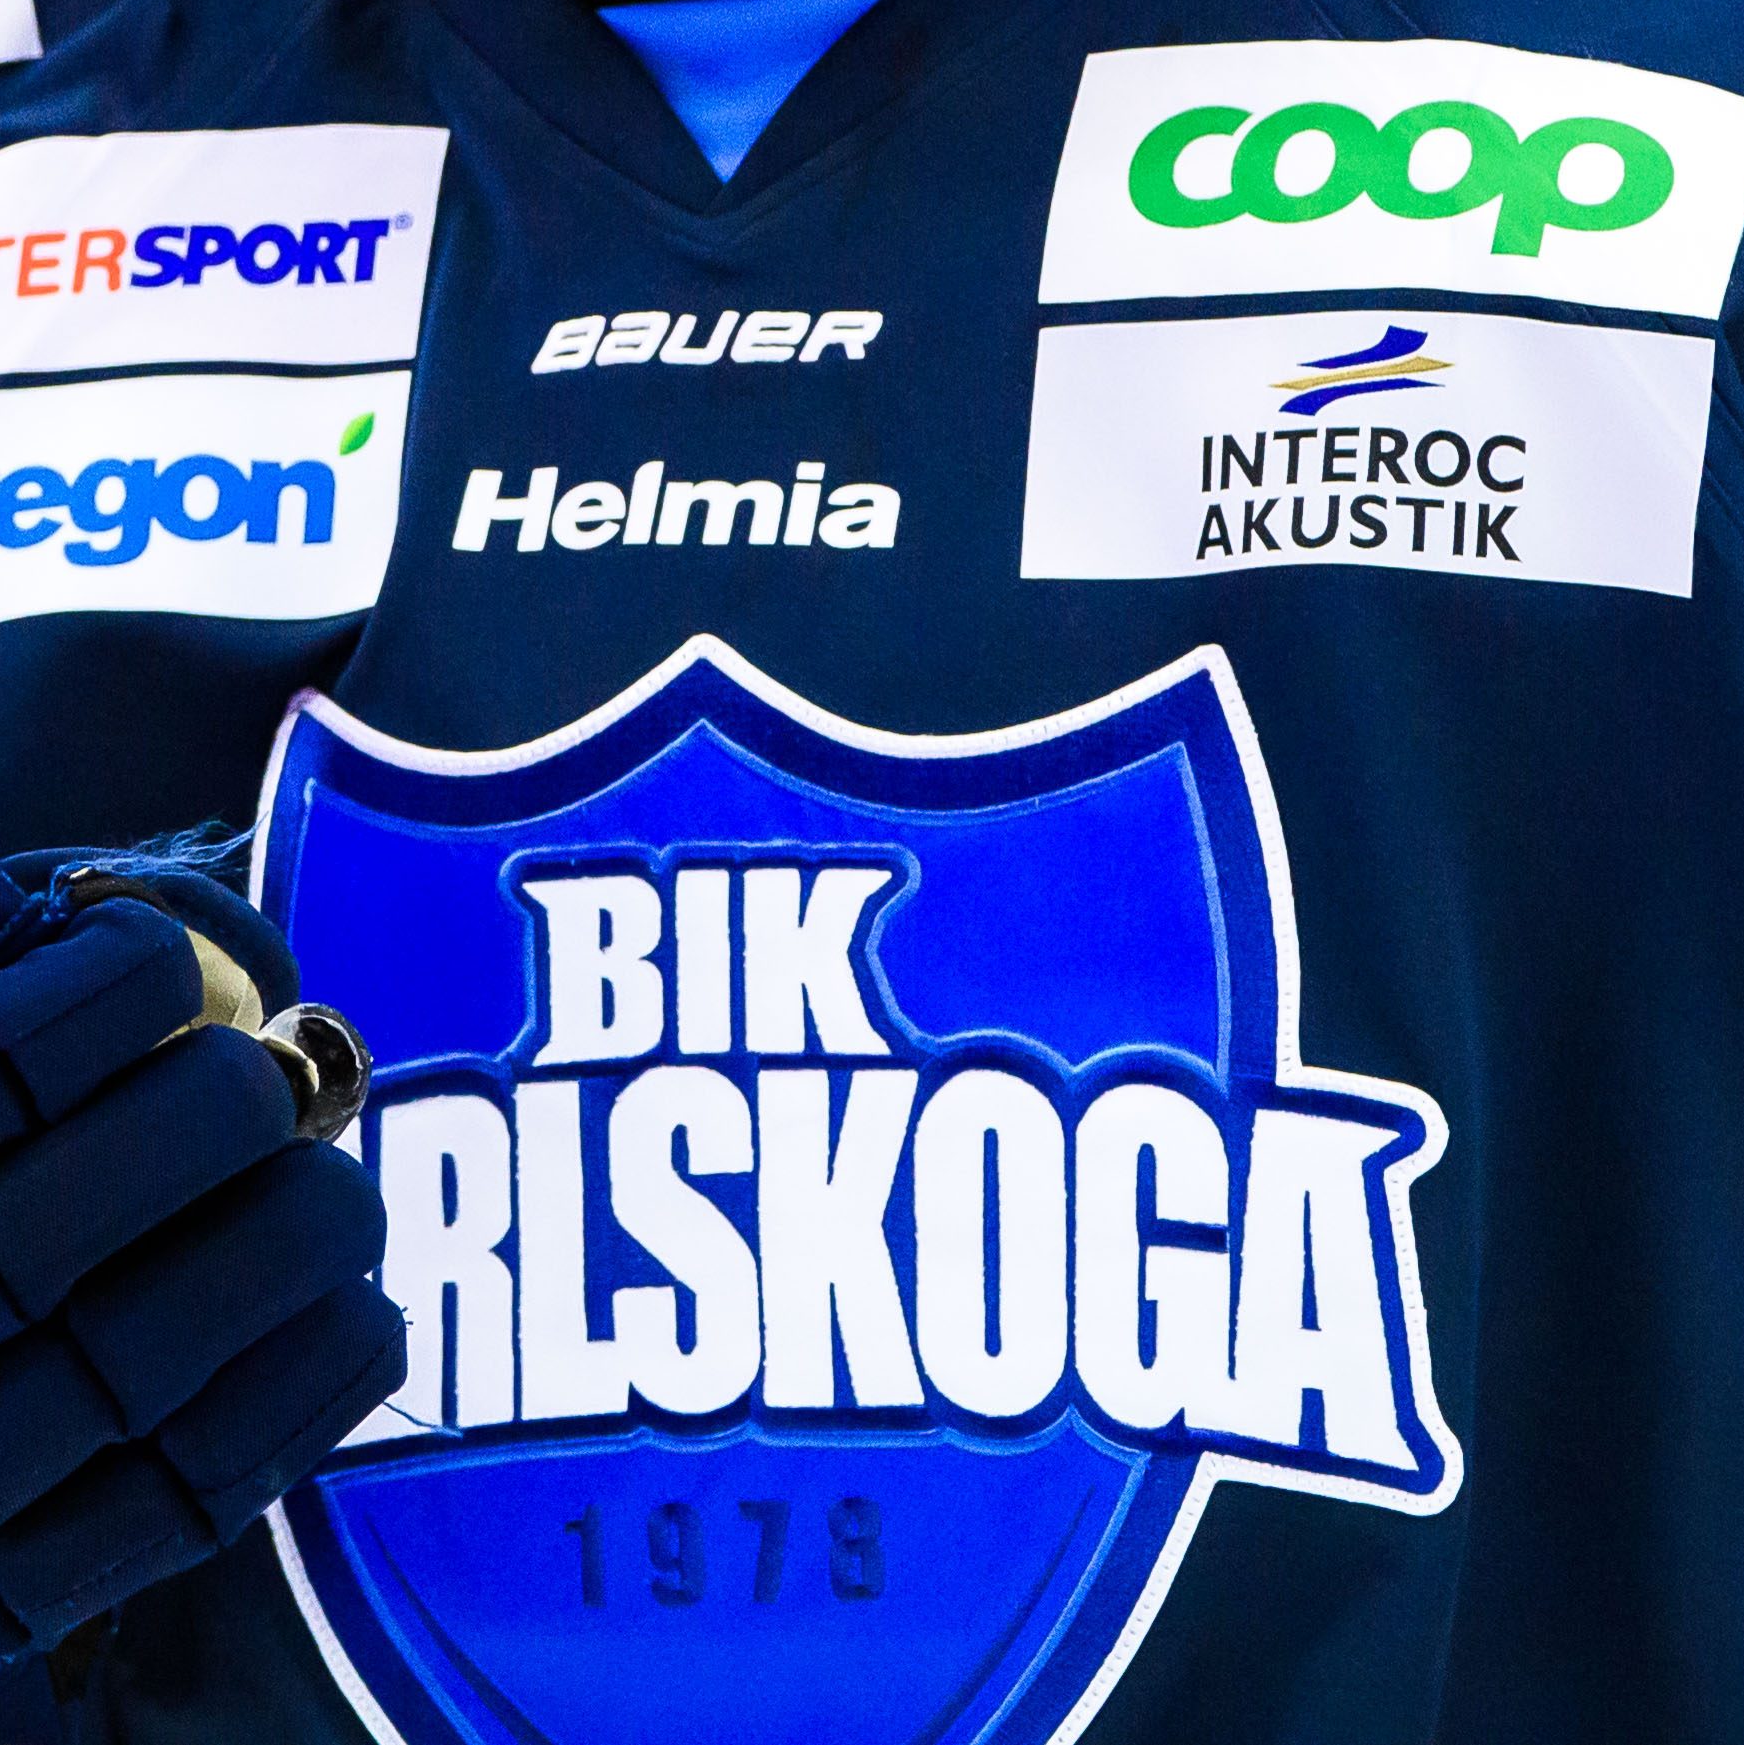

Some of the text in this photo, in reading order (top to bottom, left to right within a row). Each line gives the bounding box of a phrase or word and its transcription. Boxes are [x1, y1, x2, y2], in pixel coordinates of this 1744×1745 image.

[1127, 100, 1676, 258] coop
[530, 309, 885, 375] BAUER
[451, 459, 902, 553] Helmia
[1199, 426, 1527, 494] INTEROC
[1196, 492, 1522, 562] AKUSTIK
[522, 868, 893, 1067] BIK
[332, 1064, 1422, 1472] RLSKOGA
[564, 1495, 887, 1609] 1978
